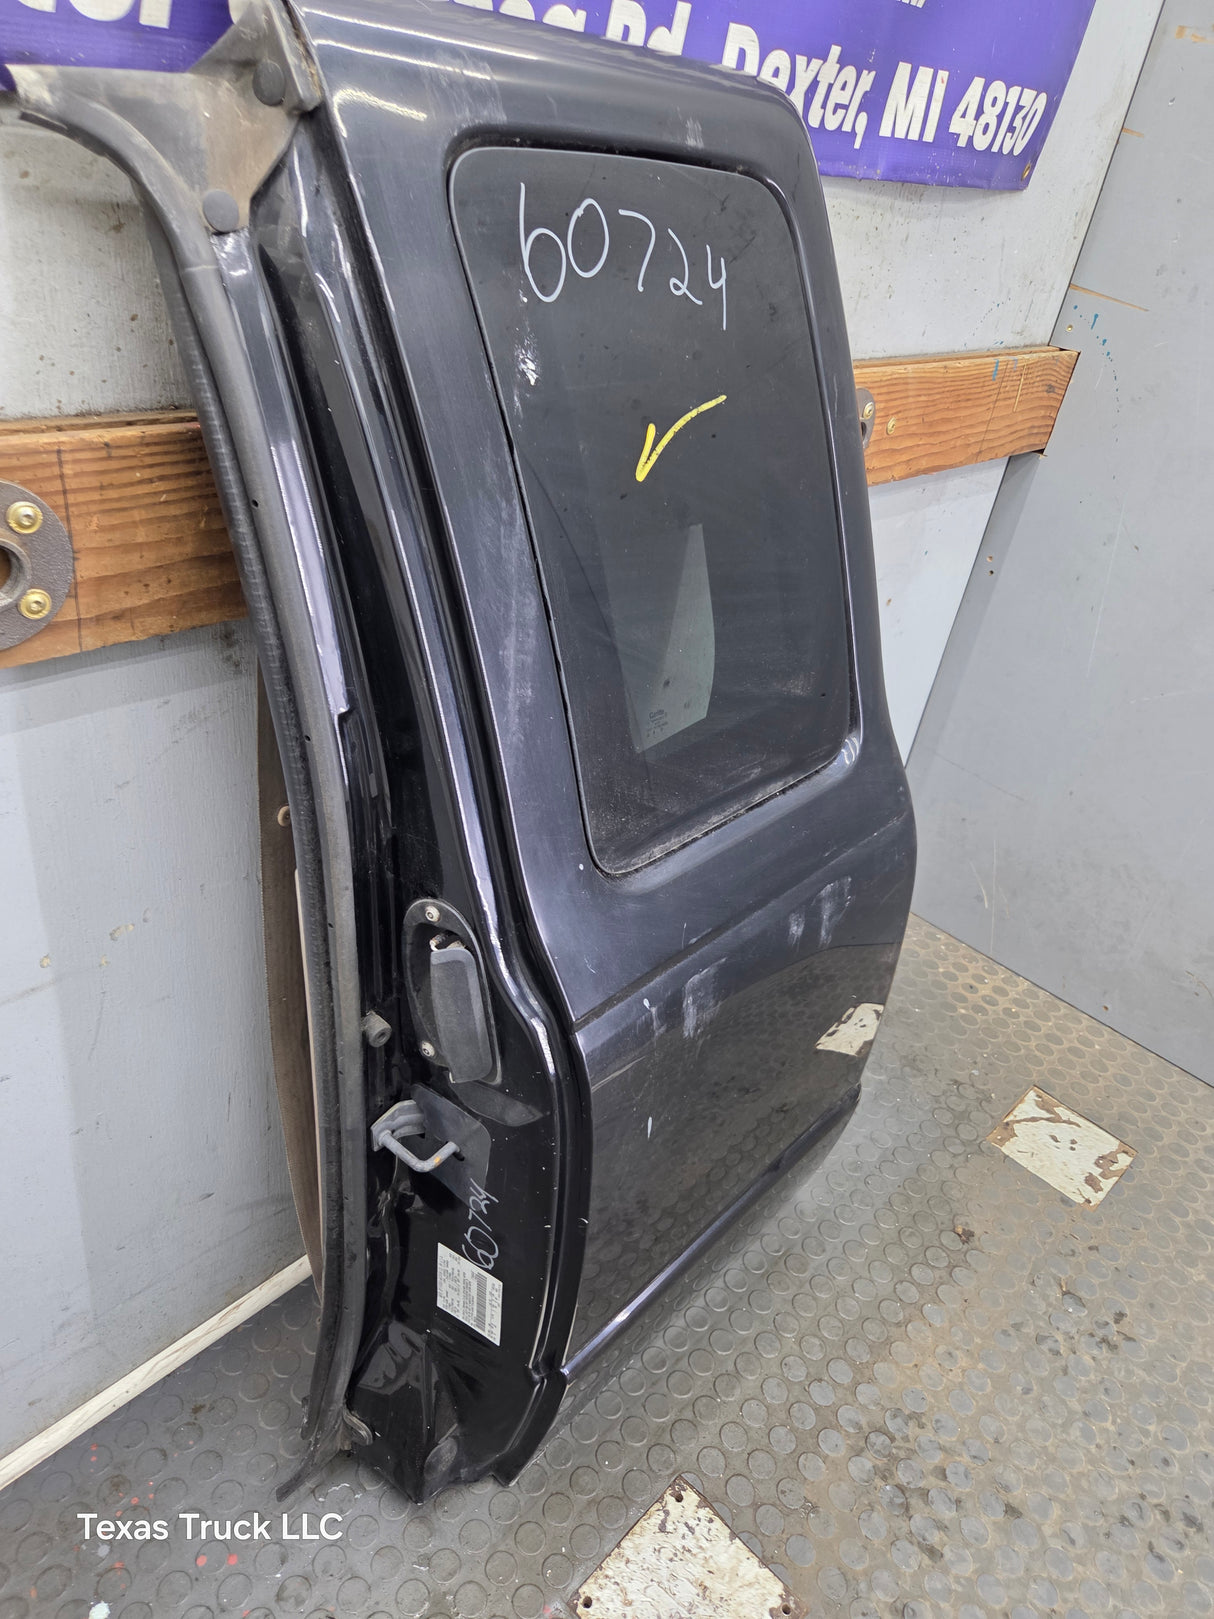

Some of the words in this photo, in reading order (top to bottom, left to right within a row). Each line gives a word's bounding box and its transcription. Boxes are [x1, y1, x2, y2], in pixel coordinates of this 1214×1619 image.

[879, 61, 949, 143] MI
[949, 76, 1047, 156] 48130
[519, 182, 727, 331] 60724
[462, 1177, 499, 1270] 60724
